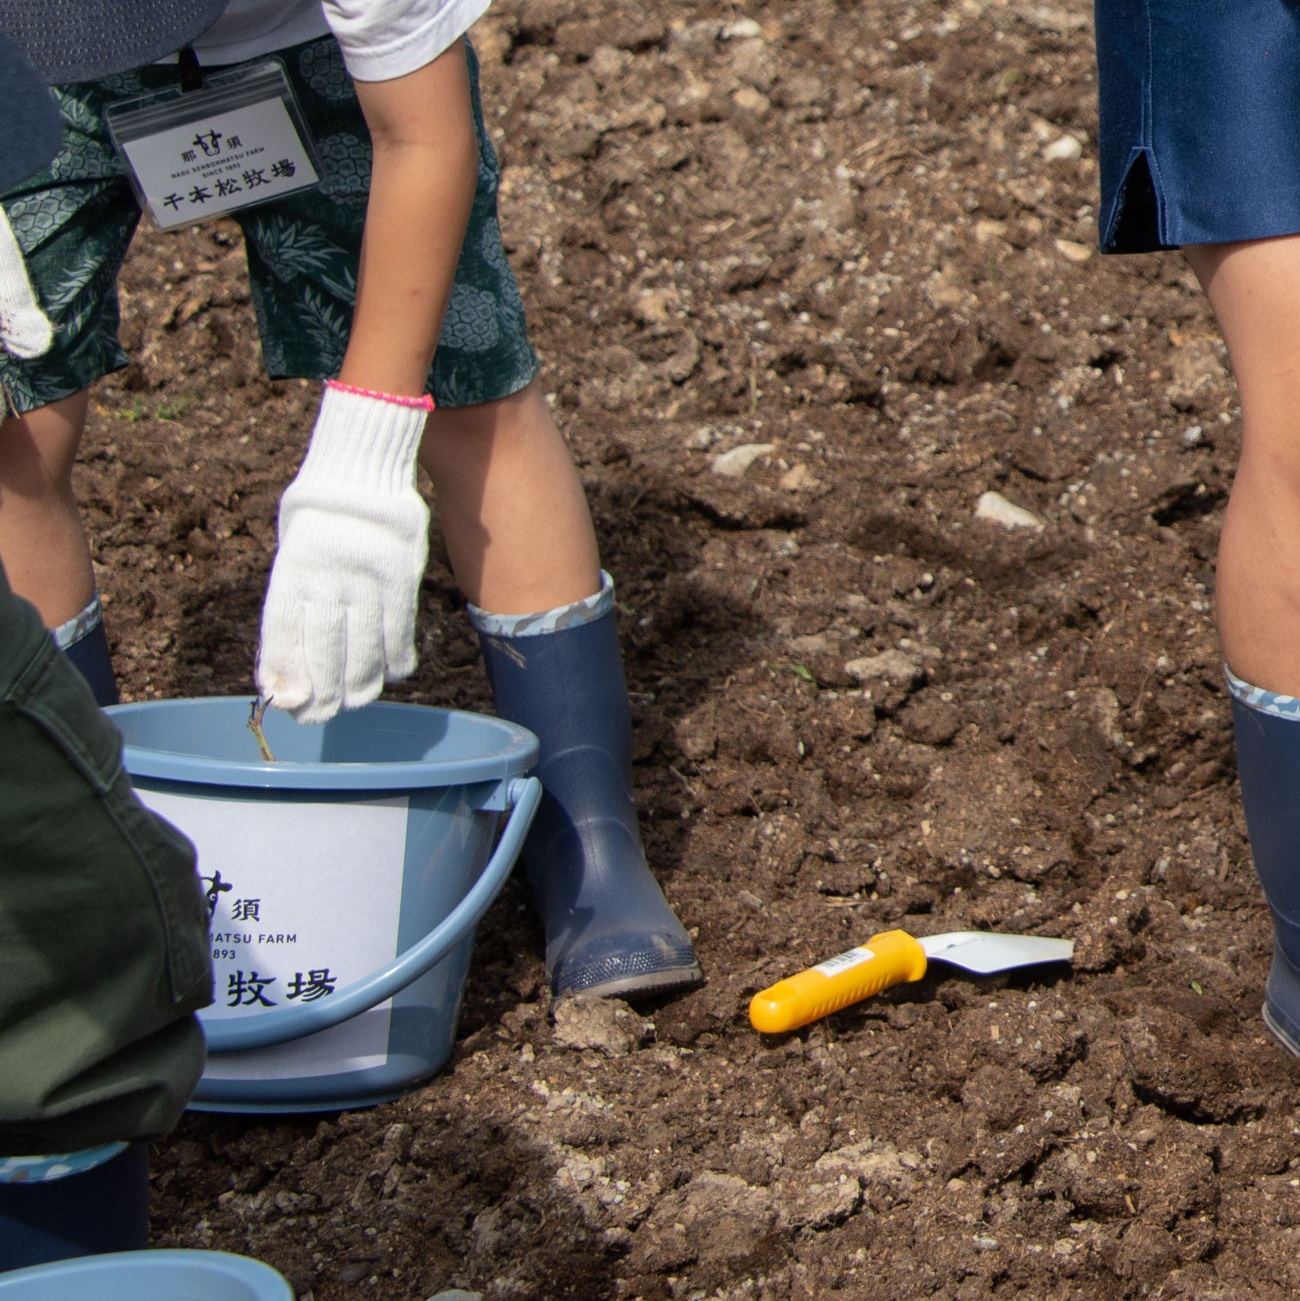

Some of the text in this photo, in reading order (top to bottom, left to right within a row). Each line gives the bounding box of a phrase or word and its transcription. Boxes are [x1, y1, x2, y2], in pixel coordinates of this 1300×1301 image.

[163, 158, 297, 212] 千本松牧場
[231, 898, 262, 923] 須
[258, 933, 297, 945] FARM
